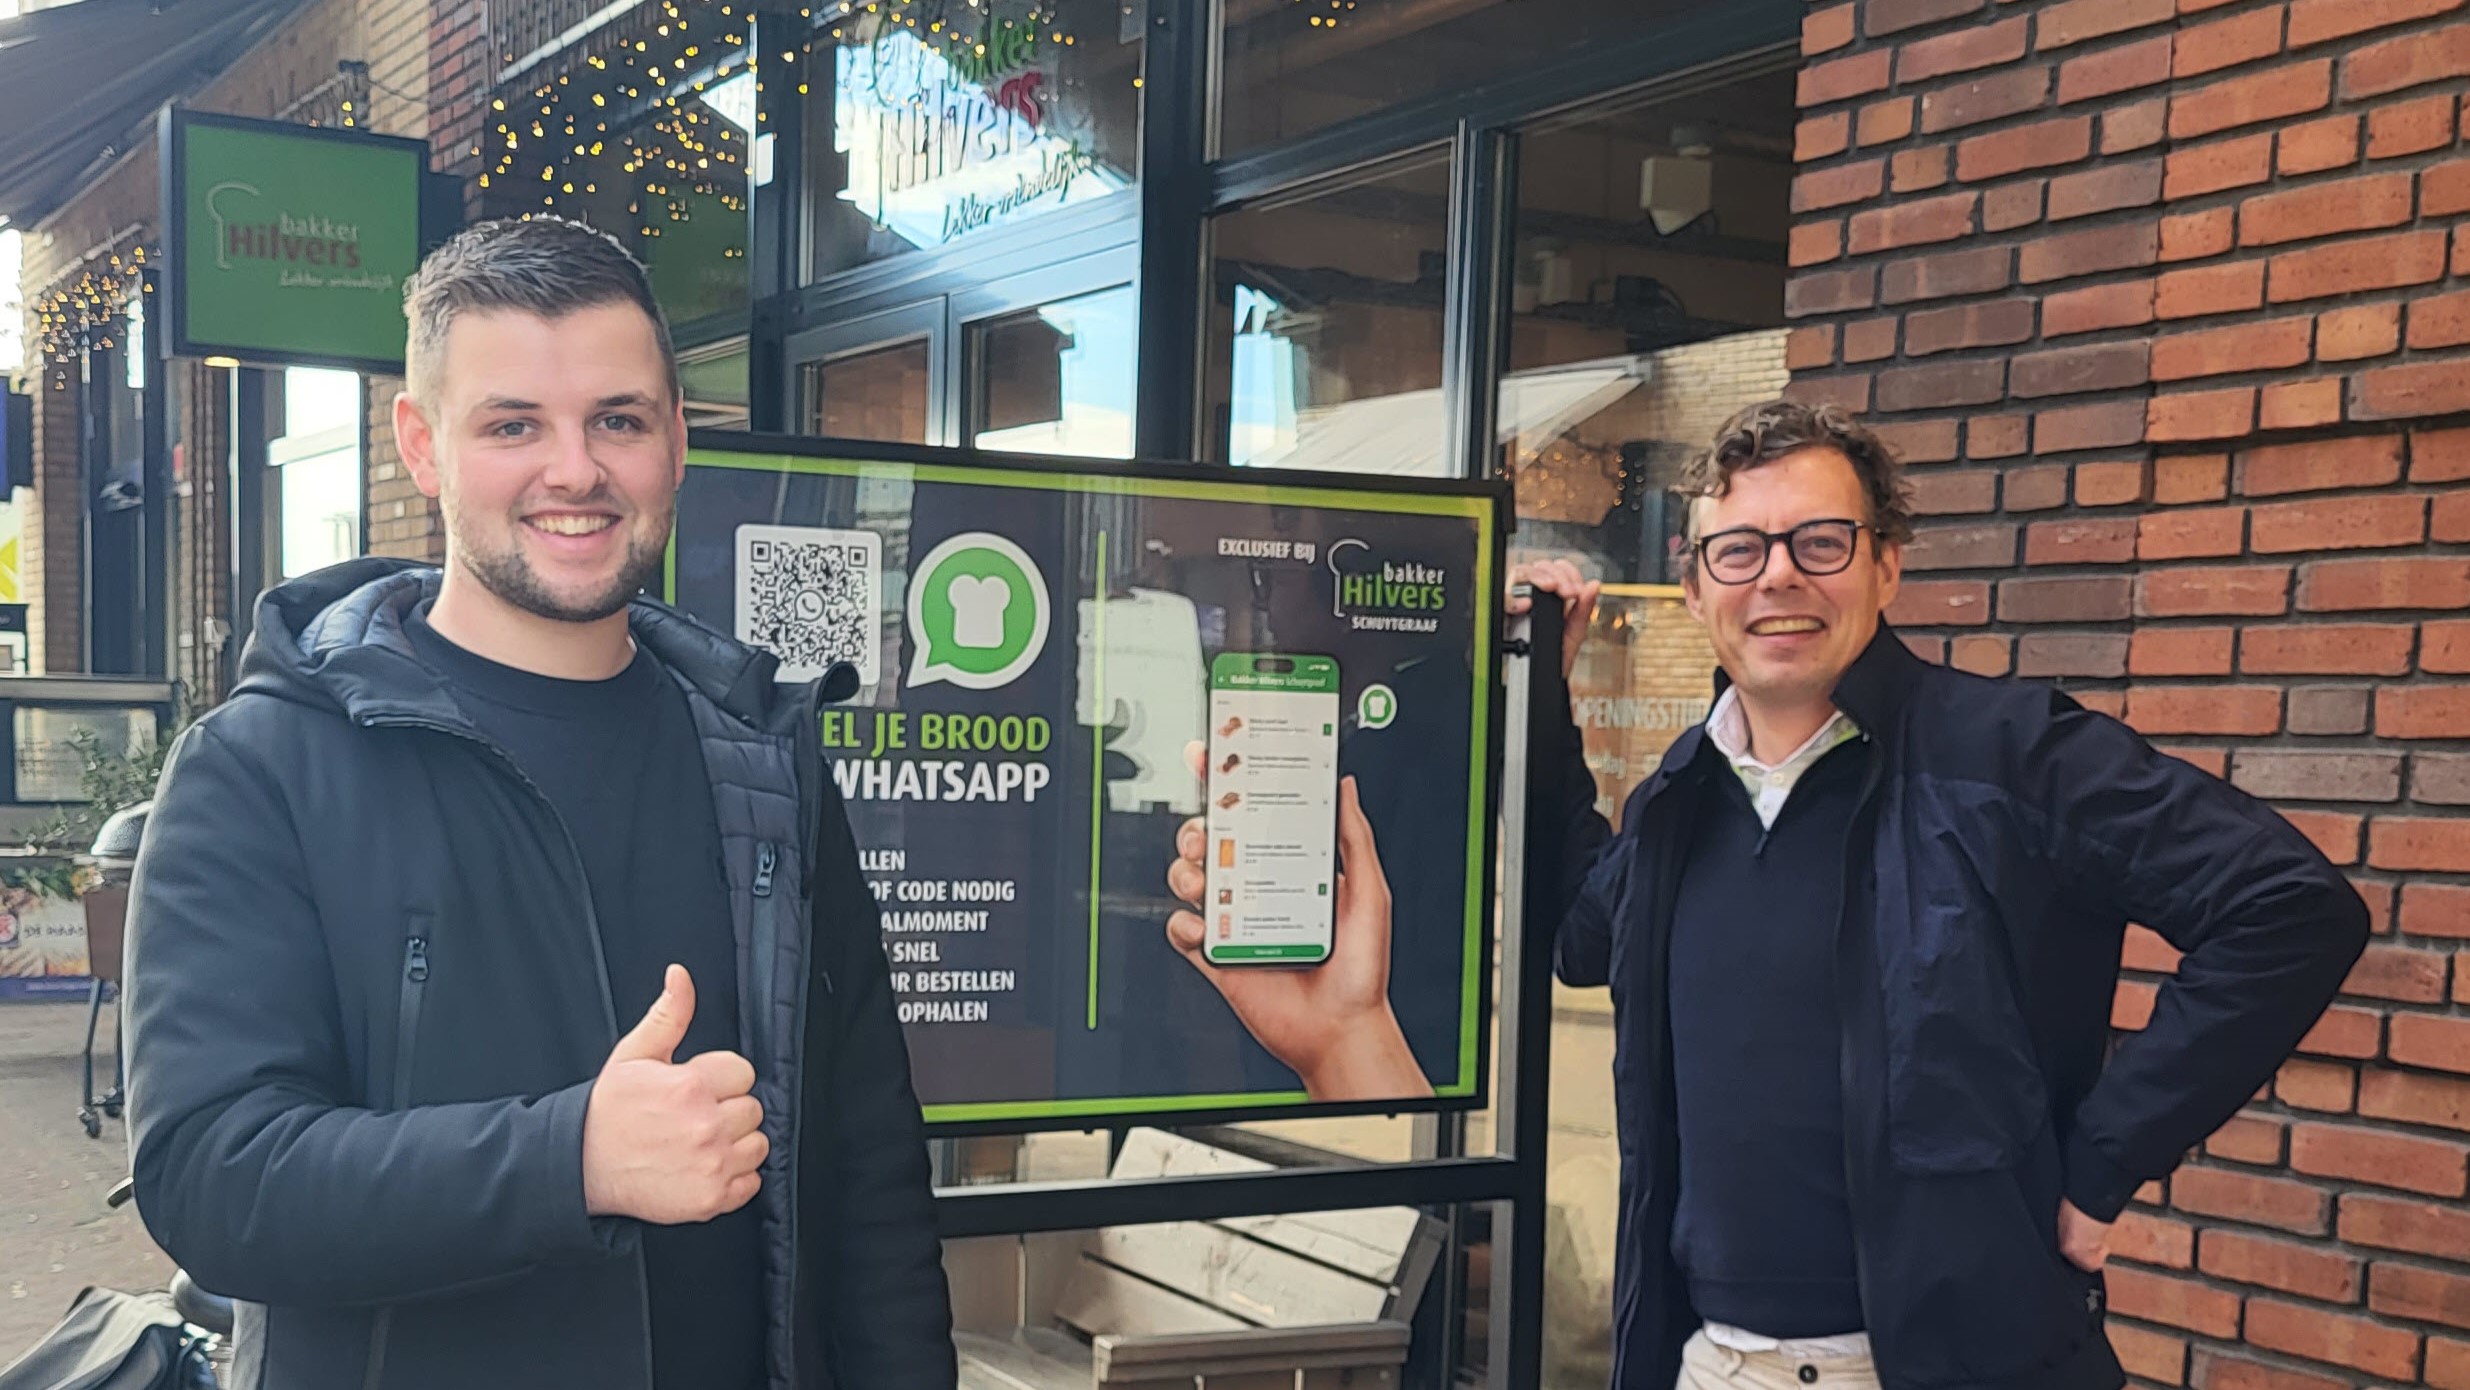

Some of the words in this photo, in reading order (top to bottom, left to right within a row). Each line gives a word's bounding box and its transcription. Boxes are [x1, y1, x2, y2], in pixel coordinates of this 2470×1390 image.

[279, 212, 359, 242] bakker
[228, 223, 361, 268] Hilvers
[1217, 538, 1292, 559] EXCLUSIEF
[1294, 541, 1316, 564] BIJ
[1383, 560, 1446, 584] bakker
[1343, 573, 1446, 610] Hilvers
[1351, 614, 1439, 632] SCHUYTGRAAF
[822, 711, 862, 748] EL
[871, 712, 907, 758] JE
[921, 713, 1050, 752] BROOD
[833, 758, 1050, 803] WHATSAPP
[859, 850, 906, 871] LLEN
[897, 880, 948, 902] CODE
[951, 880, 1015, 902] NODIG
[881, 911, 989, 932] ALMOMENT
[893, 941, 941, 963] SNEL
[915, 969, 1015, 992] BESTELLEN
[898, 1001, 989, 1023] OPHALEN
